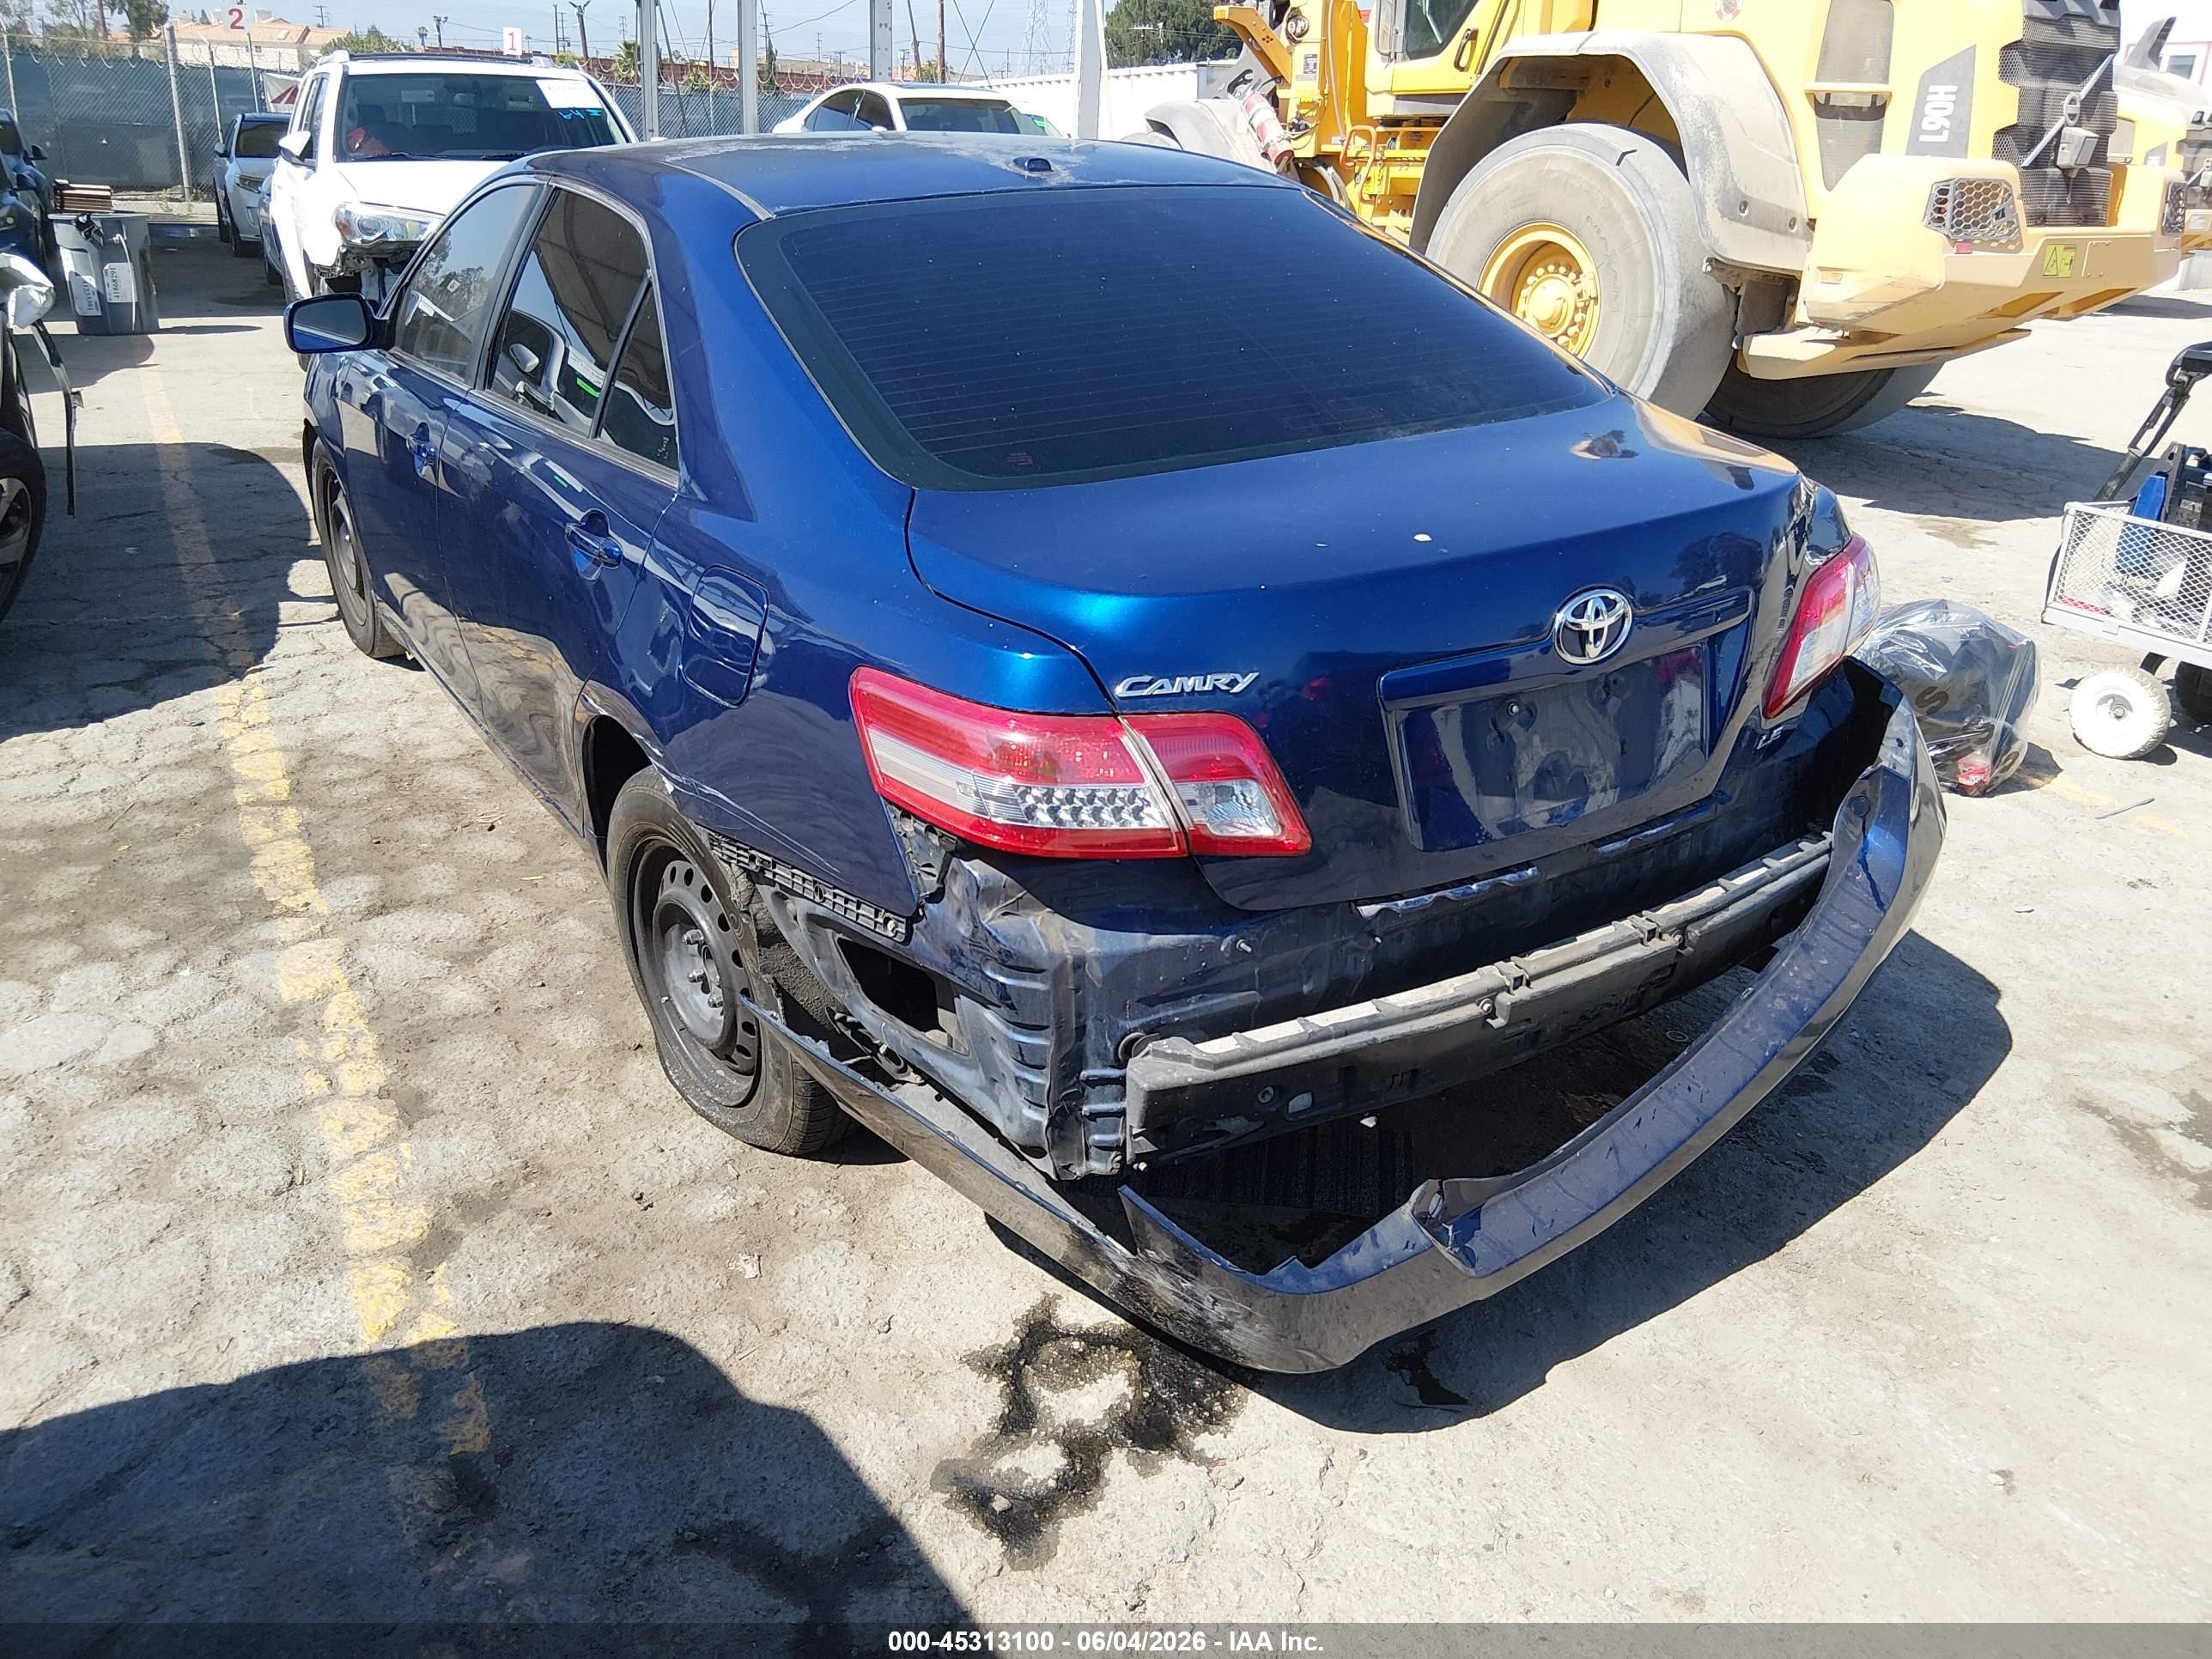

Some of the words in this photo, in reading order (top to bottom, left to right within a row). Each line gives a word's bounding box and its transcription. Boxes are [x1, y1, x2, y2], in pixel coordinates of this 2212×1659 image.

[228, 8, 245, 30] 2
[508, 32, 517, 52] 1
[1918, 85, 1959, 143] L90H
[1115, 672, 1261, 698] CAMRY
[1756, 726, 1784, 750] LE
